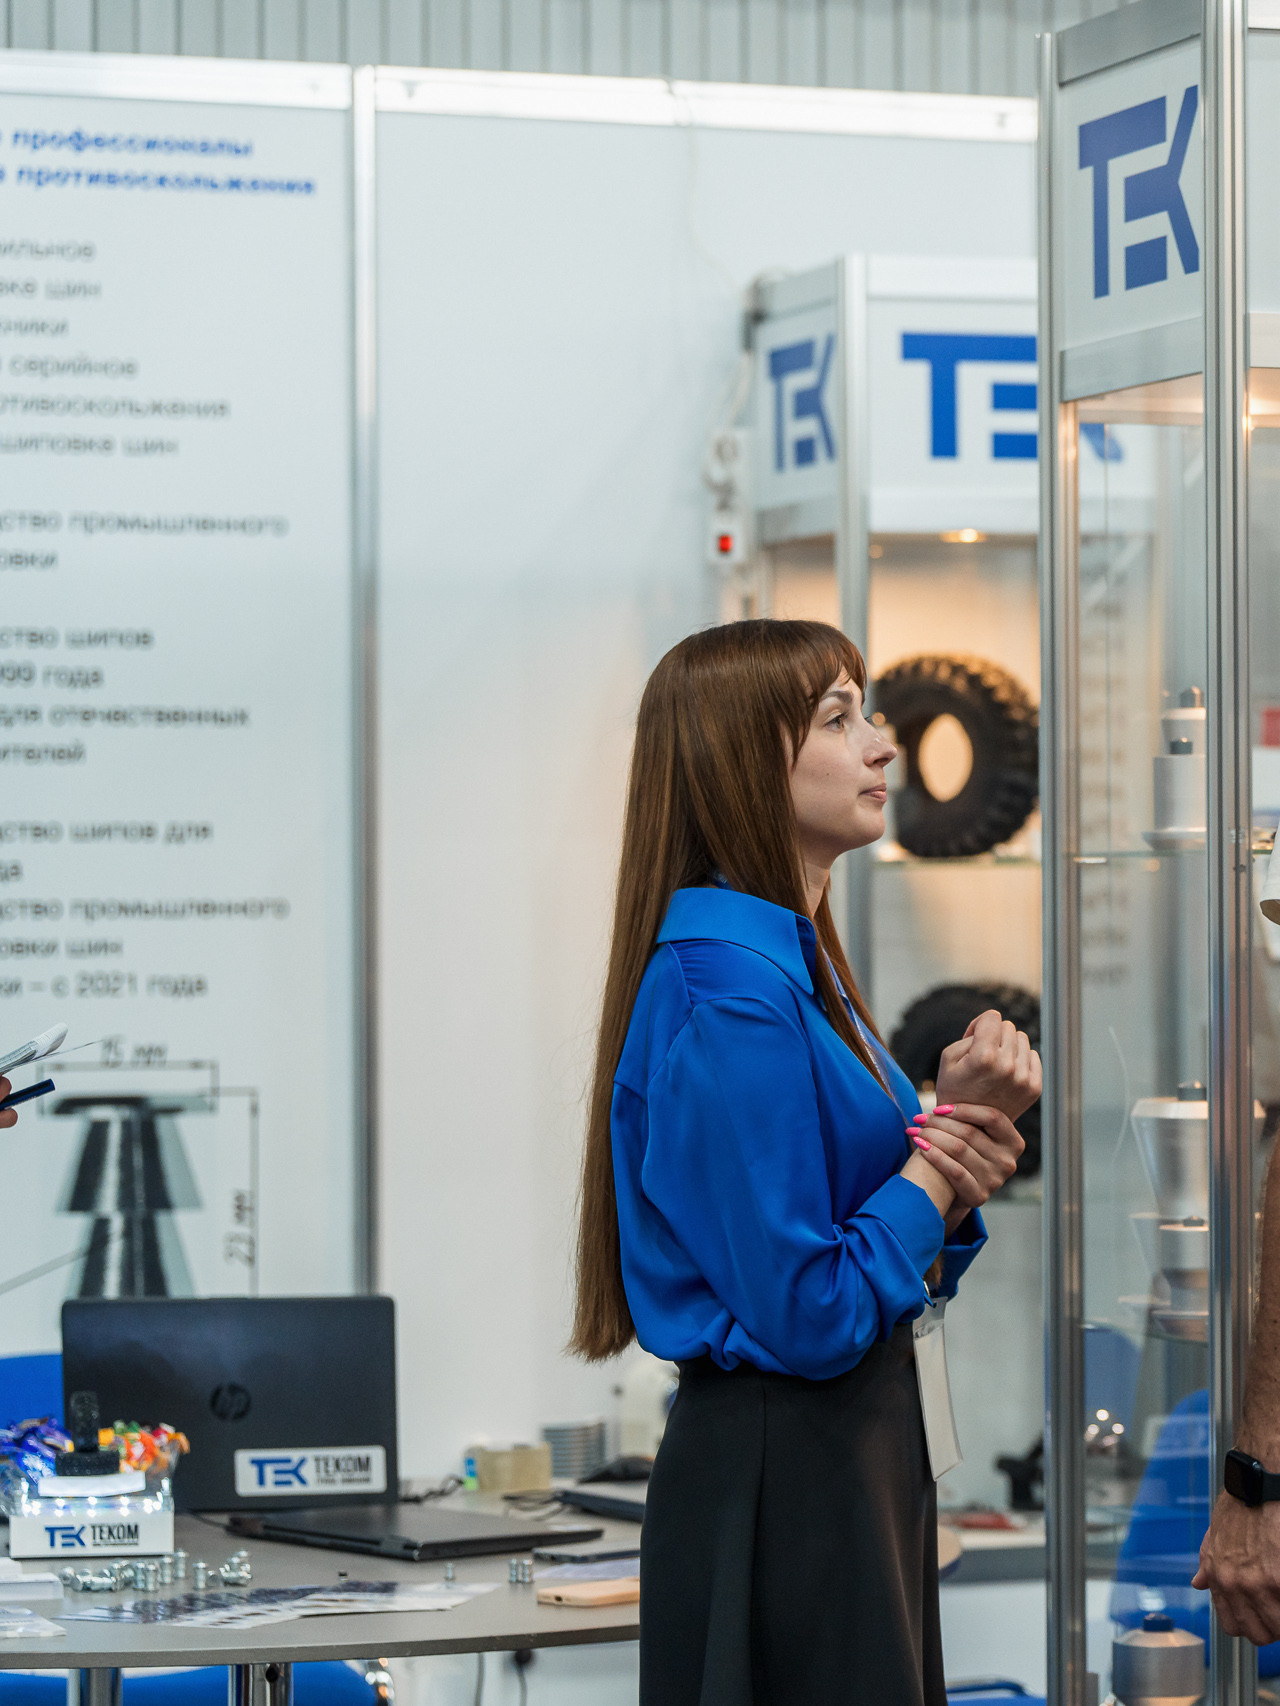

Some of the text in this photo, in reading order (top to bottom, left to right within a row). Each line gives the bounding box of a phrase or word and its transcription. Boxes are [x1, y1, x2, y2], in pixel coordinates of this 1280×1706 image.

[11, 128, 253, 158] профессионалы
[16, 166, 316, 196] противоскольжения
[1078, 84, 1199, 299] TEK
[769, 332, 836, 472] TEK
[0, 510, 290, 537] ство промышленного
[43, 667, 104, 690] года
[50, 705, 250, 728] отечественных
[0, 821, 64, 844] ство
[163, 821, 214, 845] для
[0, 898, 290, 923] ство промышленного
[75, 970, 138, 998] 2021
[146, 975, 208, 999] года
[250, 1456, 308, 1487] TEK
[45, 1523, 139, 1548] TEK TEKOM
